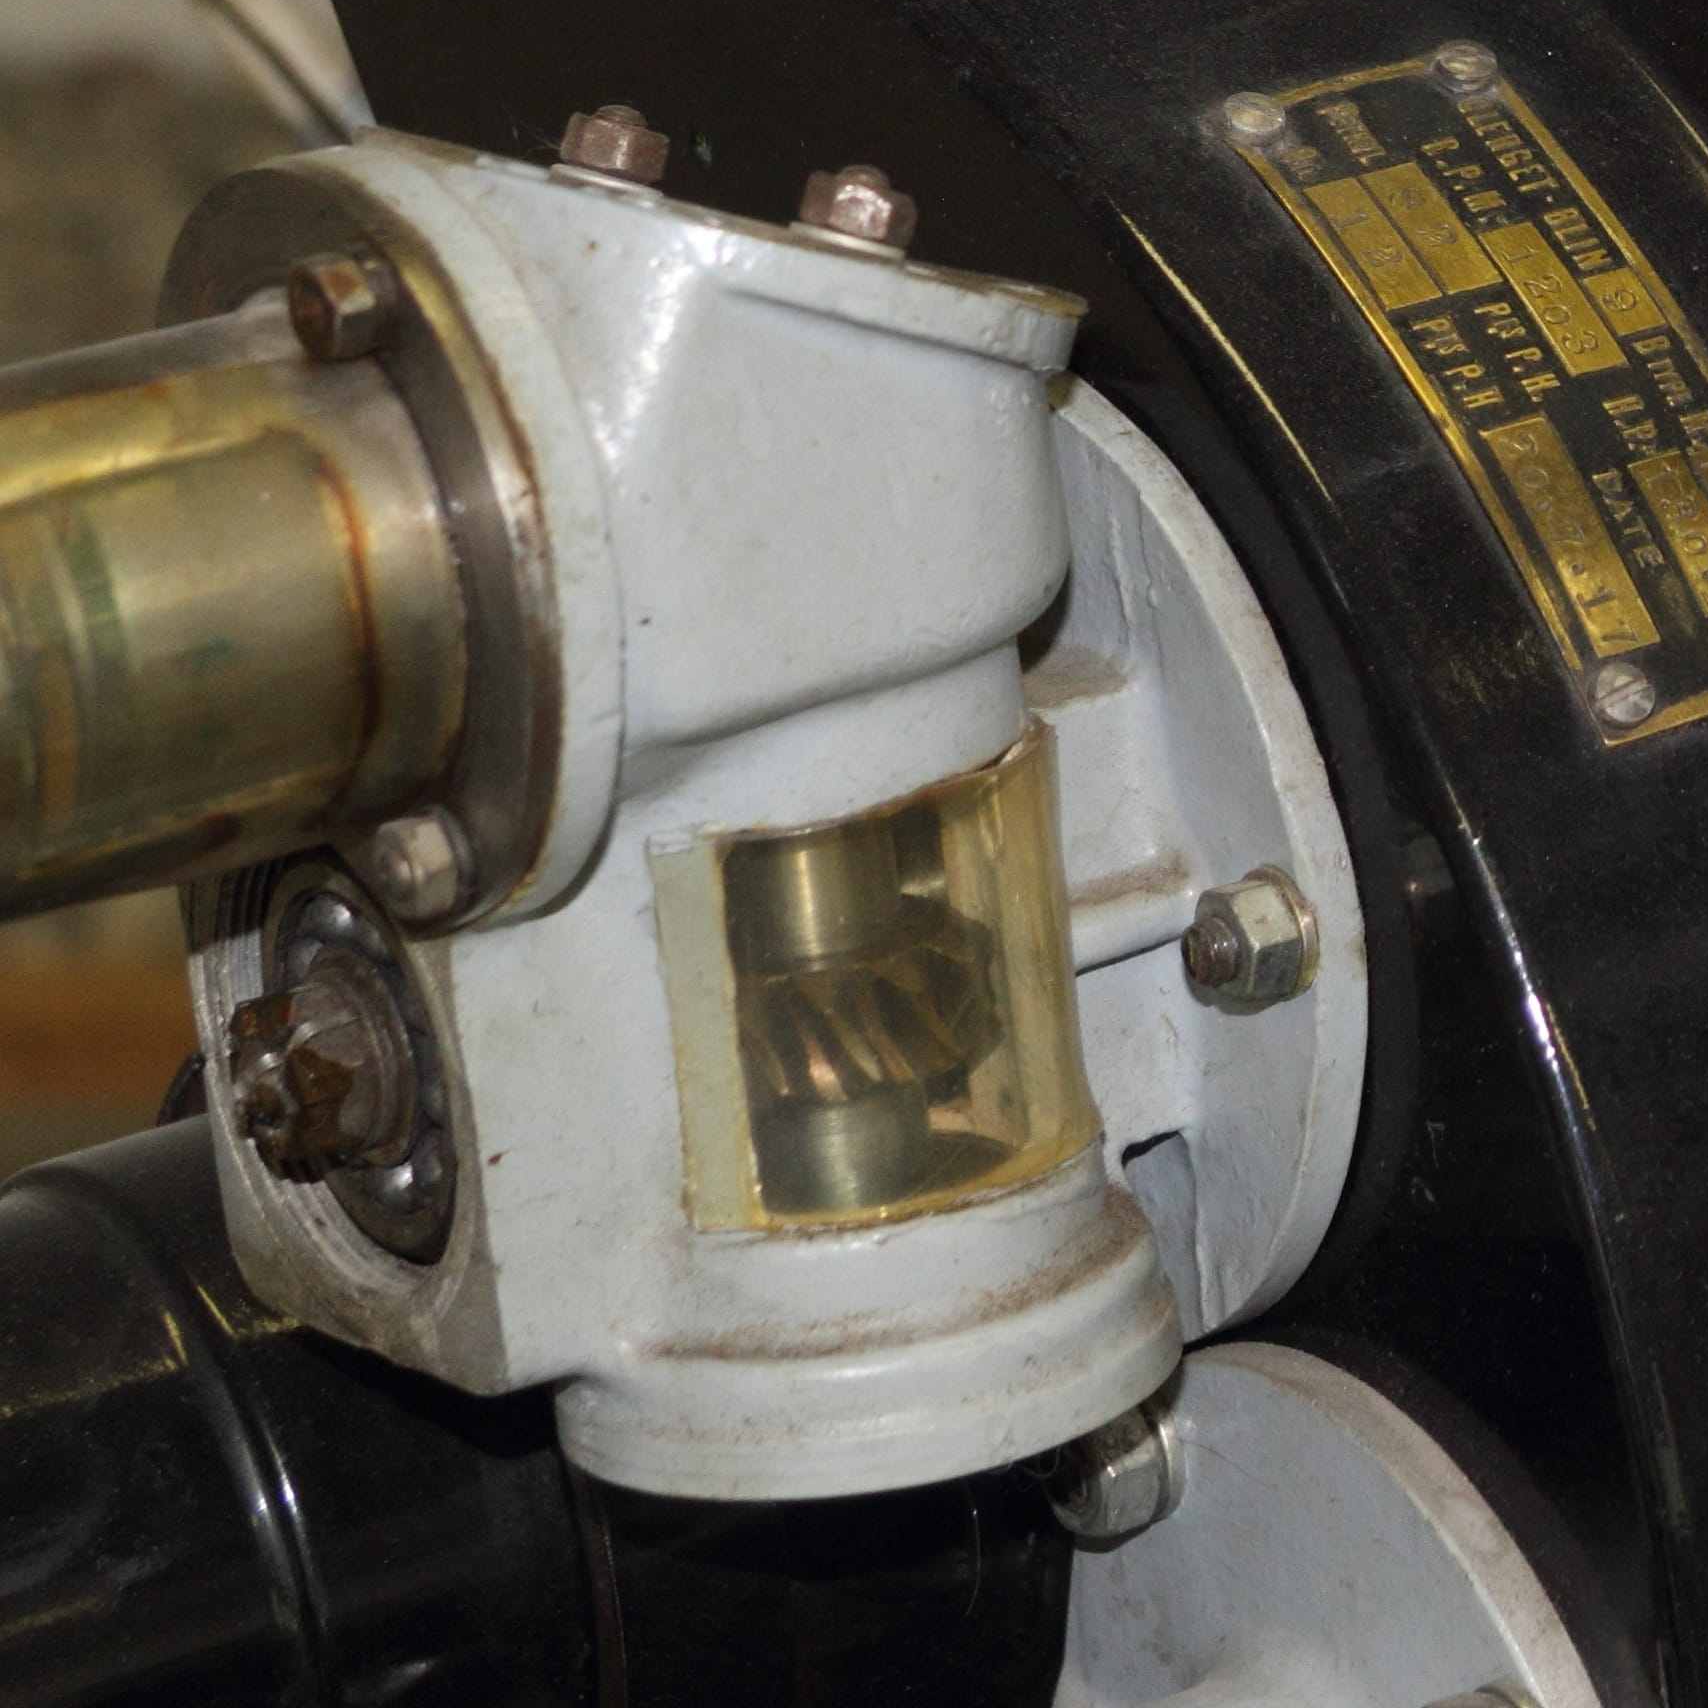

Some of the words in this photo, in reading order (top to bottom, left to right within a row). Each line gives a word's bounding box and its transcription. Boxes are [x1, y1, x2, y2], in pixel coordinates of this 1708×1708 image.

[1326, 205, 1407, 271] 12
[1498, 240, 1604, 357] 1203
[1597, 284, 1643, 317] 9
[1630, 333, 1674, 357] B
[1590, 467, 1667, 569] DATE
